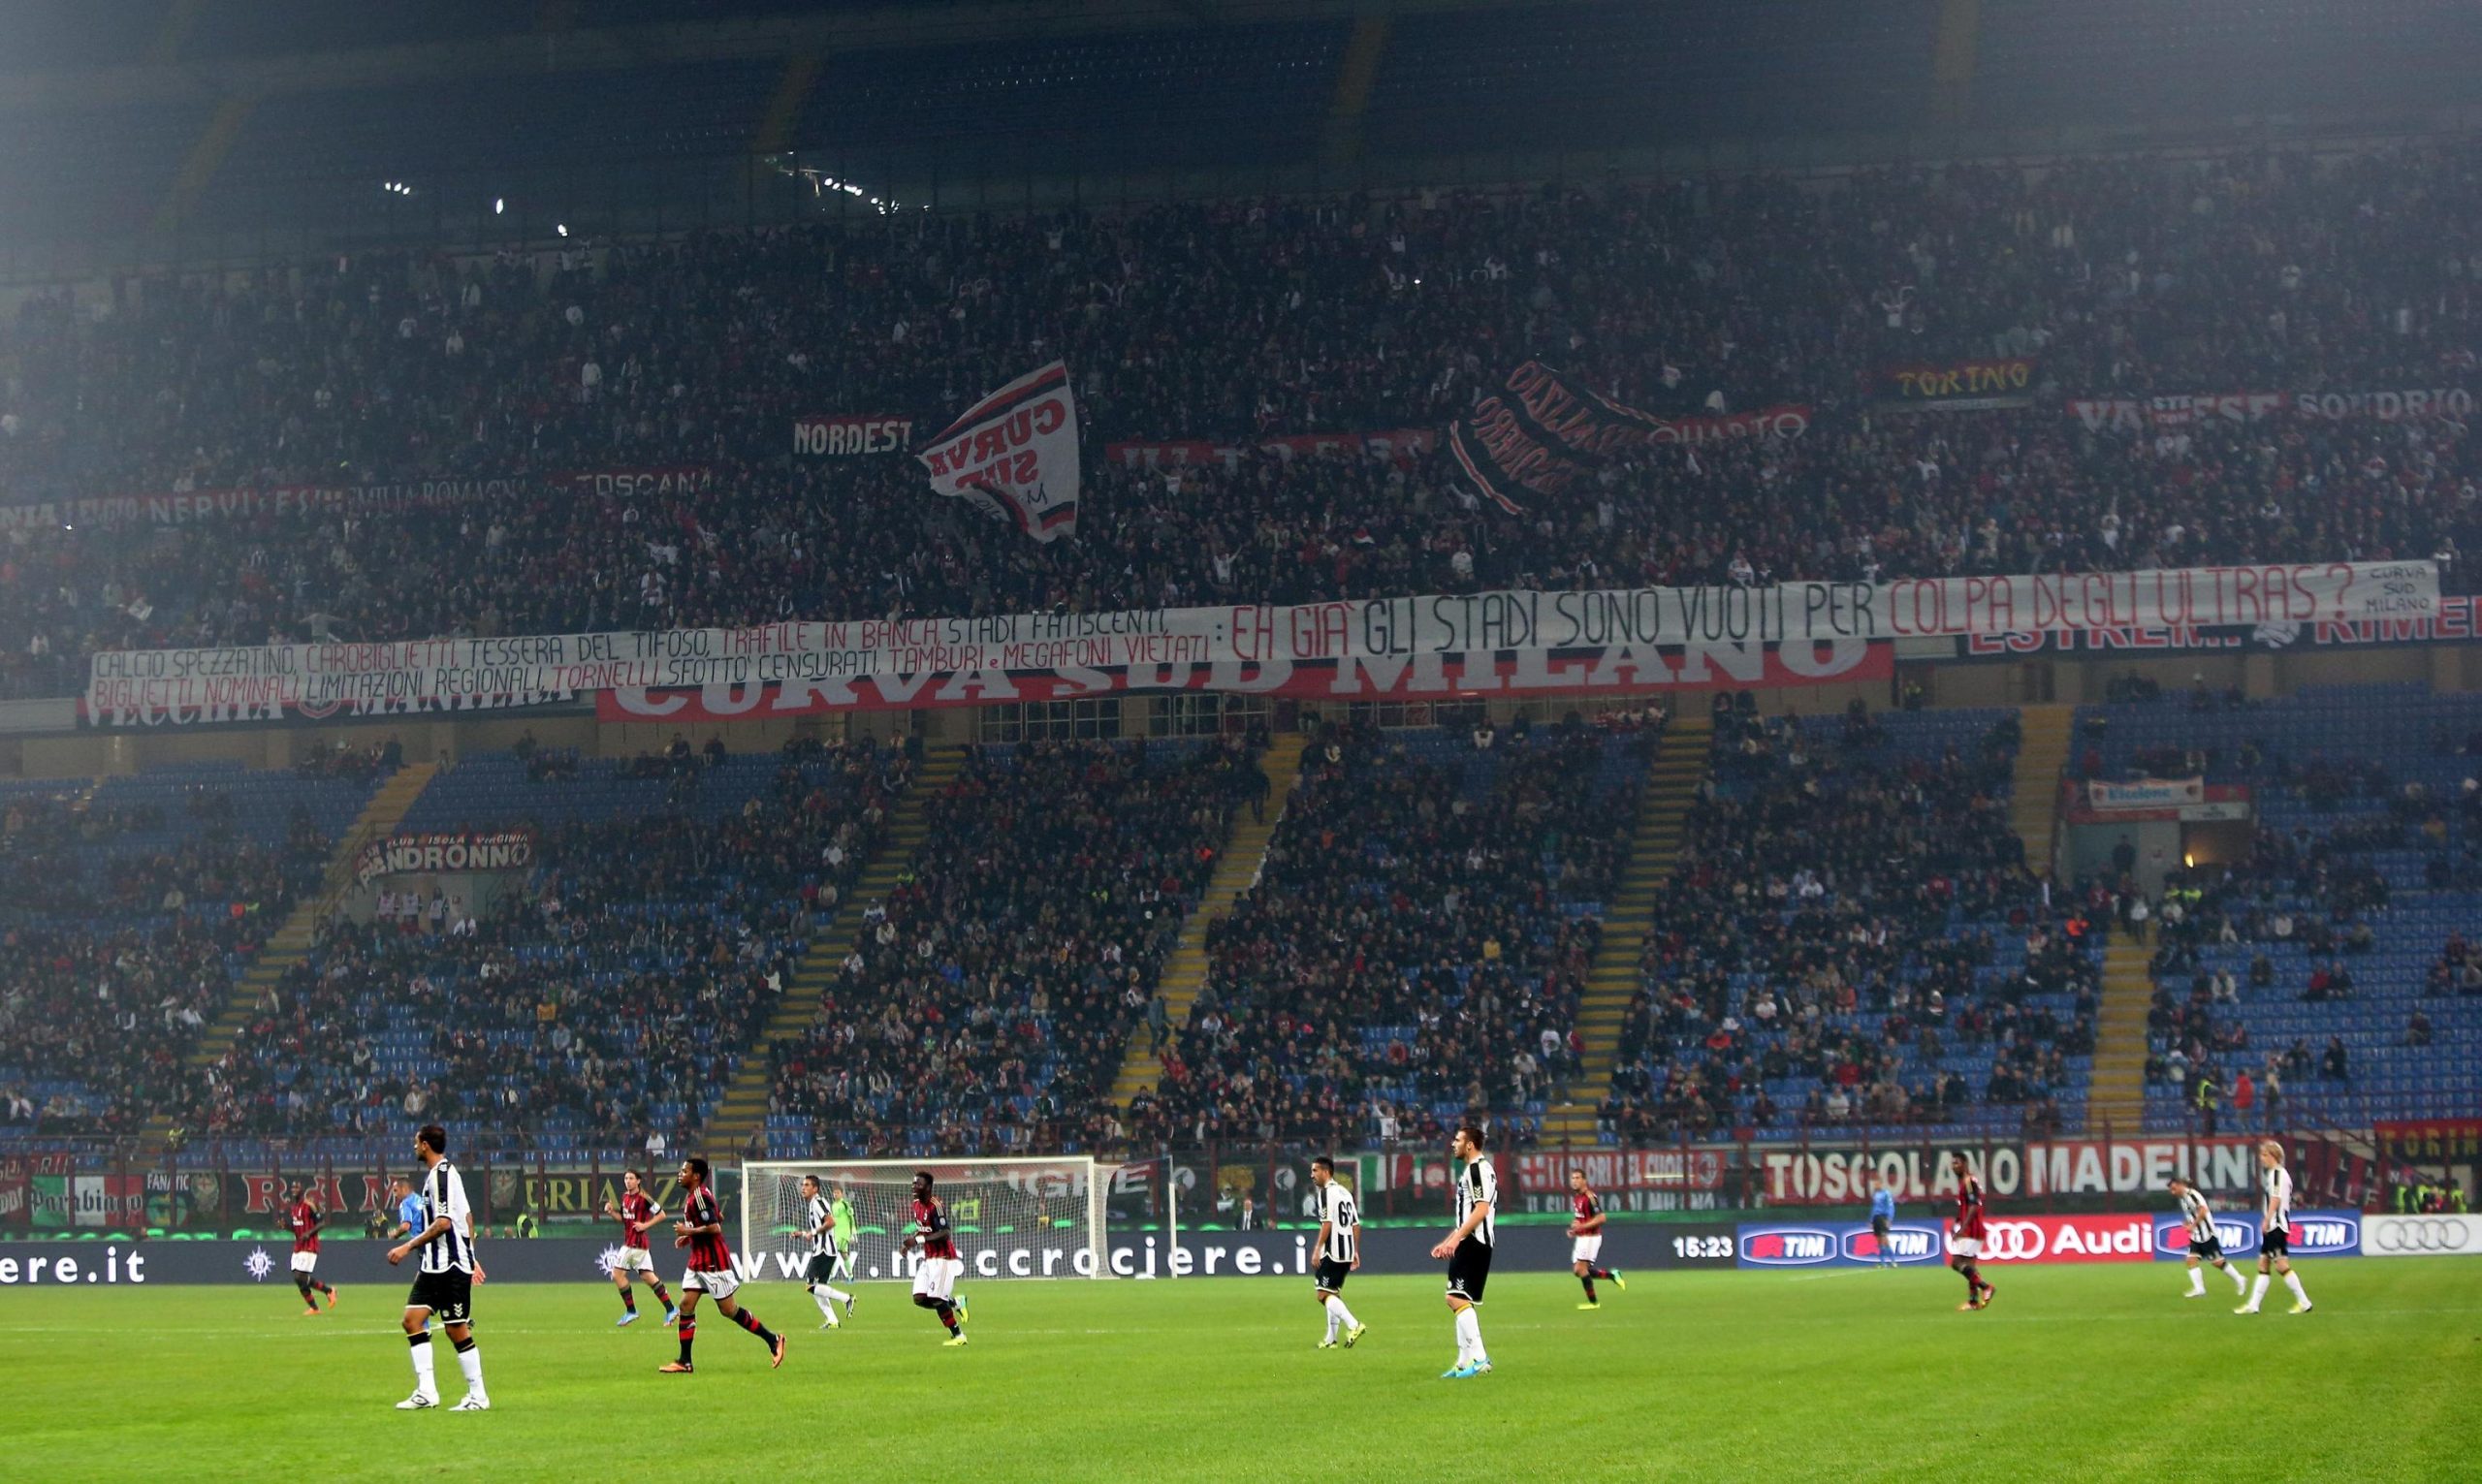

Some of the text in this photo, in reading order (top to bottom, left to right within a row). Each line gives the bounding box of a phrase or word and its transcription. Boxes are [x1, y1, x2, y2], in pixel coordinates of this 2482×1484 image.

[1897, 362, 2030, 396] TORINO
[794, 421, 912, 457] NORDEST
[2370, 566, 2428, 580] CURVA
[2382, 583, 2417, 595] SUD
[1232, 605, 1274, 661] EH
[1364, 597, 1416, 656] GLI
[1434, 592, 1537, 654] STADI
[1555, 589, 1660, 647] SONO
[1677, 583, 1784, 643] VUOTI
[1805, 583, 1877, 639] PER
[1890, 576, 2014, 636] COLPA
[2032, 571, 2139, 630] DEGLI
[2157, 565, 2318, 626] ULTRAS
[2365, 596, 2431, 614] MILANO
[96, 650, 166, 678] CALCIO
[174, 647, 298, 677] SPEZZATINO,
[305, 639, 459, 675] CAROBIGLIETTI,
[471, 636, 563, 668] TESSERA
[579, 634, 620, 662] DEL
[630, 630, 712, 659] TIFOSO,
[721, 622, 811, 655] TRAFILE
[825, 623, 849, 649] IN
[949, 616, 1017, 644] STADI
[93, 679, 196, 709] BIGLIETTI
[204, 675, 302, 705] NOMINALI,
[306, 670, 426, 702] LIMITAZIONI
[435, 667, 547, 696] REGIONALI,
[551, 660, 663, 690] TORNELLI,
[758, 649, 881, 681] CENSURATI,
[889, 644, 982, 676] TAMBURI
[989, 658, 1000, 669] e
[1004, 638, 1112, 670] MEGAFONI
[1125, 635, 1209, 665] VIETATI
[2026, 1142, 2257, 1194] MADERN
[1672, 1236, 1734, 1258] 15:23
[1783, 1237, 1827, 1258] TIM
[1887, 1235, 1928, 1256] TIM
[2052, 1223, 2152, 1256] Audi
[2304, 1225, 2347, 1247] TIM
